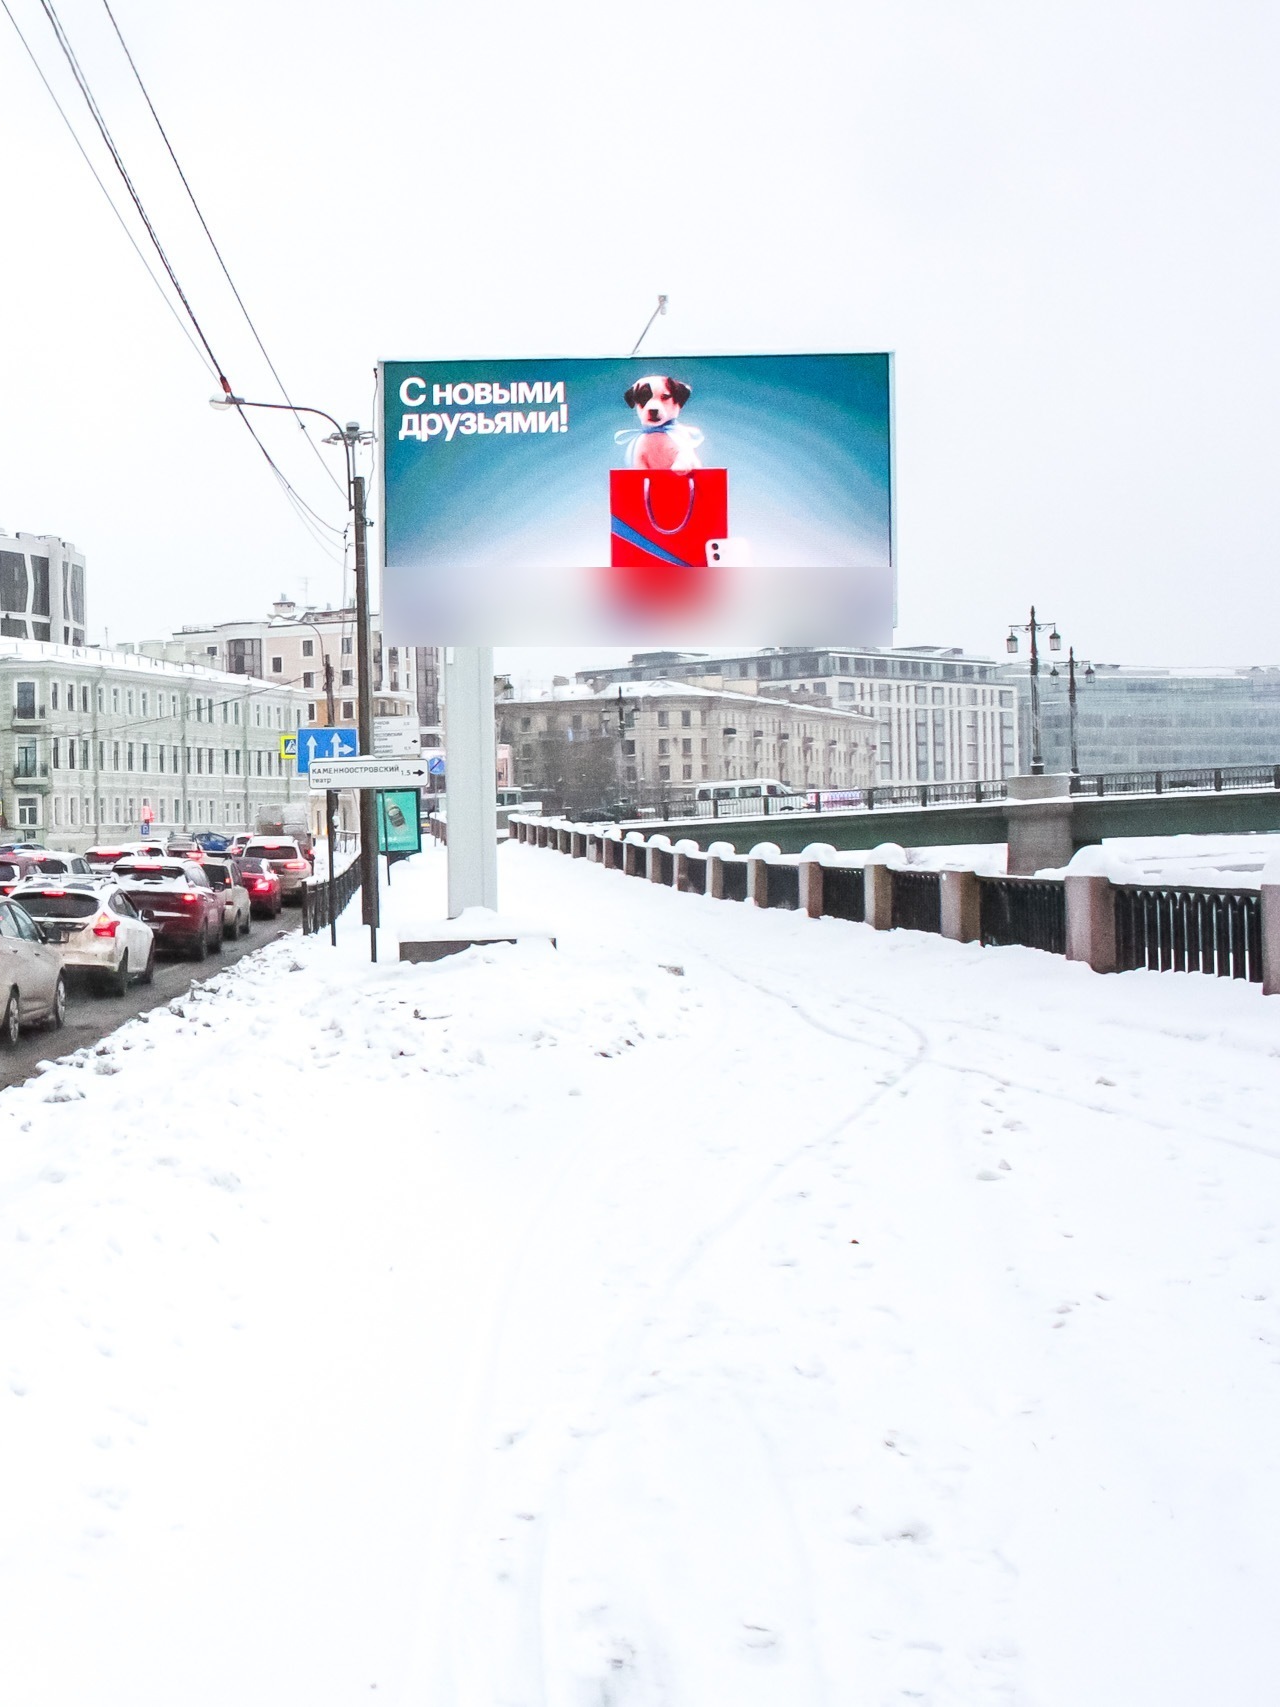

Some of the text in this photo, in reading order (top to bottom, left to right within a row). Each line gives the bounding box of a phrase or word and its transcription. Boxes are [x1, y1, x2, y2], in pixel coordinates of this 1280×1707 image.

[399, 376, 564, 407] С новыми
[398, 404, 568, 441] друзьями!
[312, 764, 400, 774] КАМЕННООСТРОВСКИЙ
